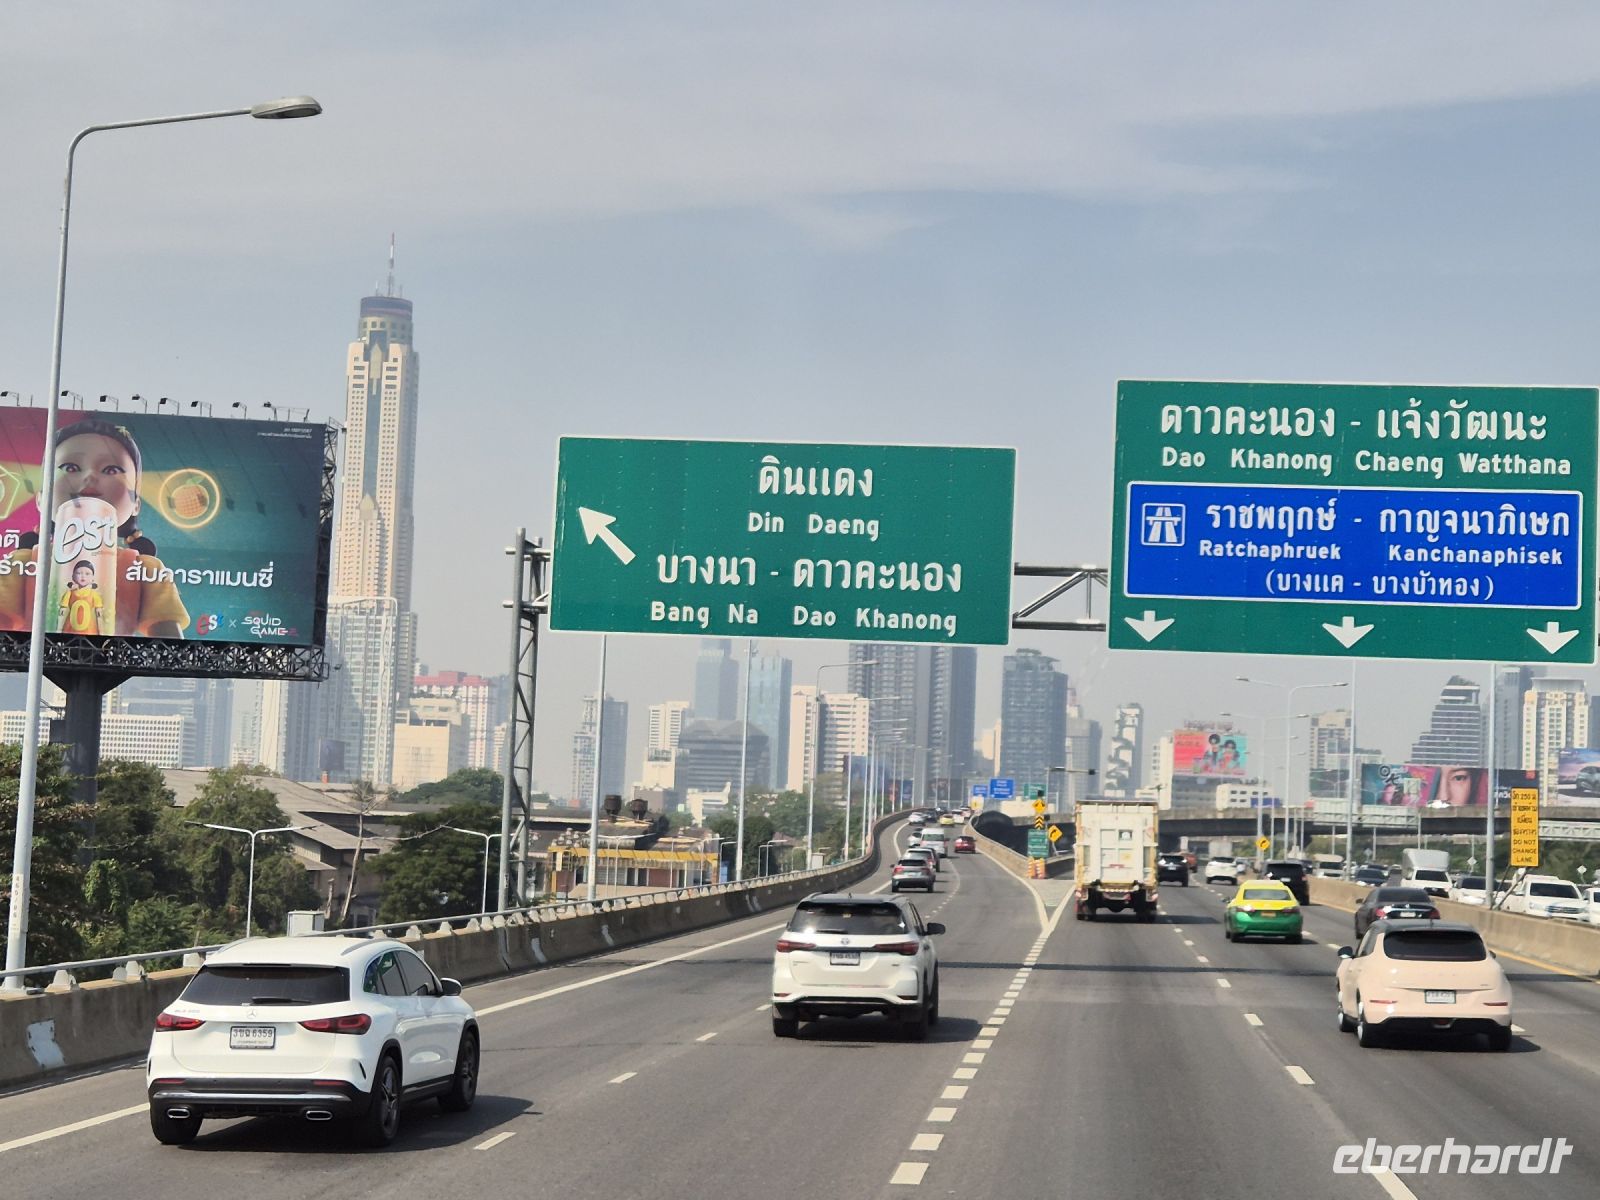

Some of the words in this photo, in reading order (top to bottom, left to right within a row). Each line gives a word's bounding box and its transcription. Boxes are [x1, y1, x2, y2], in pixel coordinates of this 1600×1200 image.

[1161, 404, 1335, 437] ดาวคะนอง
[1377, 397, 1547, 441] แจ้งวัฒนะ
[758, 455, 873, 497] ดินแดง
[1162, 446, 1206, 467] Dao
[1231, 448, 1332, 477] Khanong
[1355, 450, 1443, 480] Chaeng
[1458, 452, 1571, 475] Watthana
[748, 511, 784, 534] Din
[808, 513, 880, 542] Daeng
[1206, 497, 1337, 538] ราชพฤกษ์
[1380, 503, 1569, 543] กาญจนาภิเษก
[54, 517, 115, 565] est
[1199, 539, 1341, 561] Ratchaphruek
[1389, 544, 1563, 567] Kanchanaphisek
[125, 560, 274, 588] ส้มคาราแมนซี่
[657, 553, 756, 586] บางนา
[793, 558, 962, 593] ดาวคะนอง
[1265, 568, 1344, 594] (บางแค
[651, 601, 710, 629] Bang
[728, 603, 759, 625] Na
[793, 605, 837, 628] Dao
[856, 607, 958, 637] Khanong
